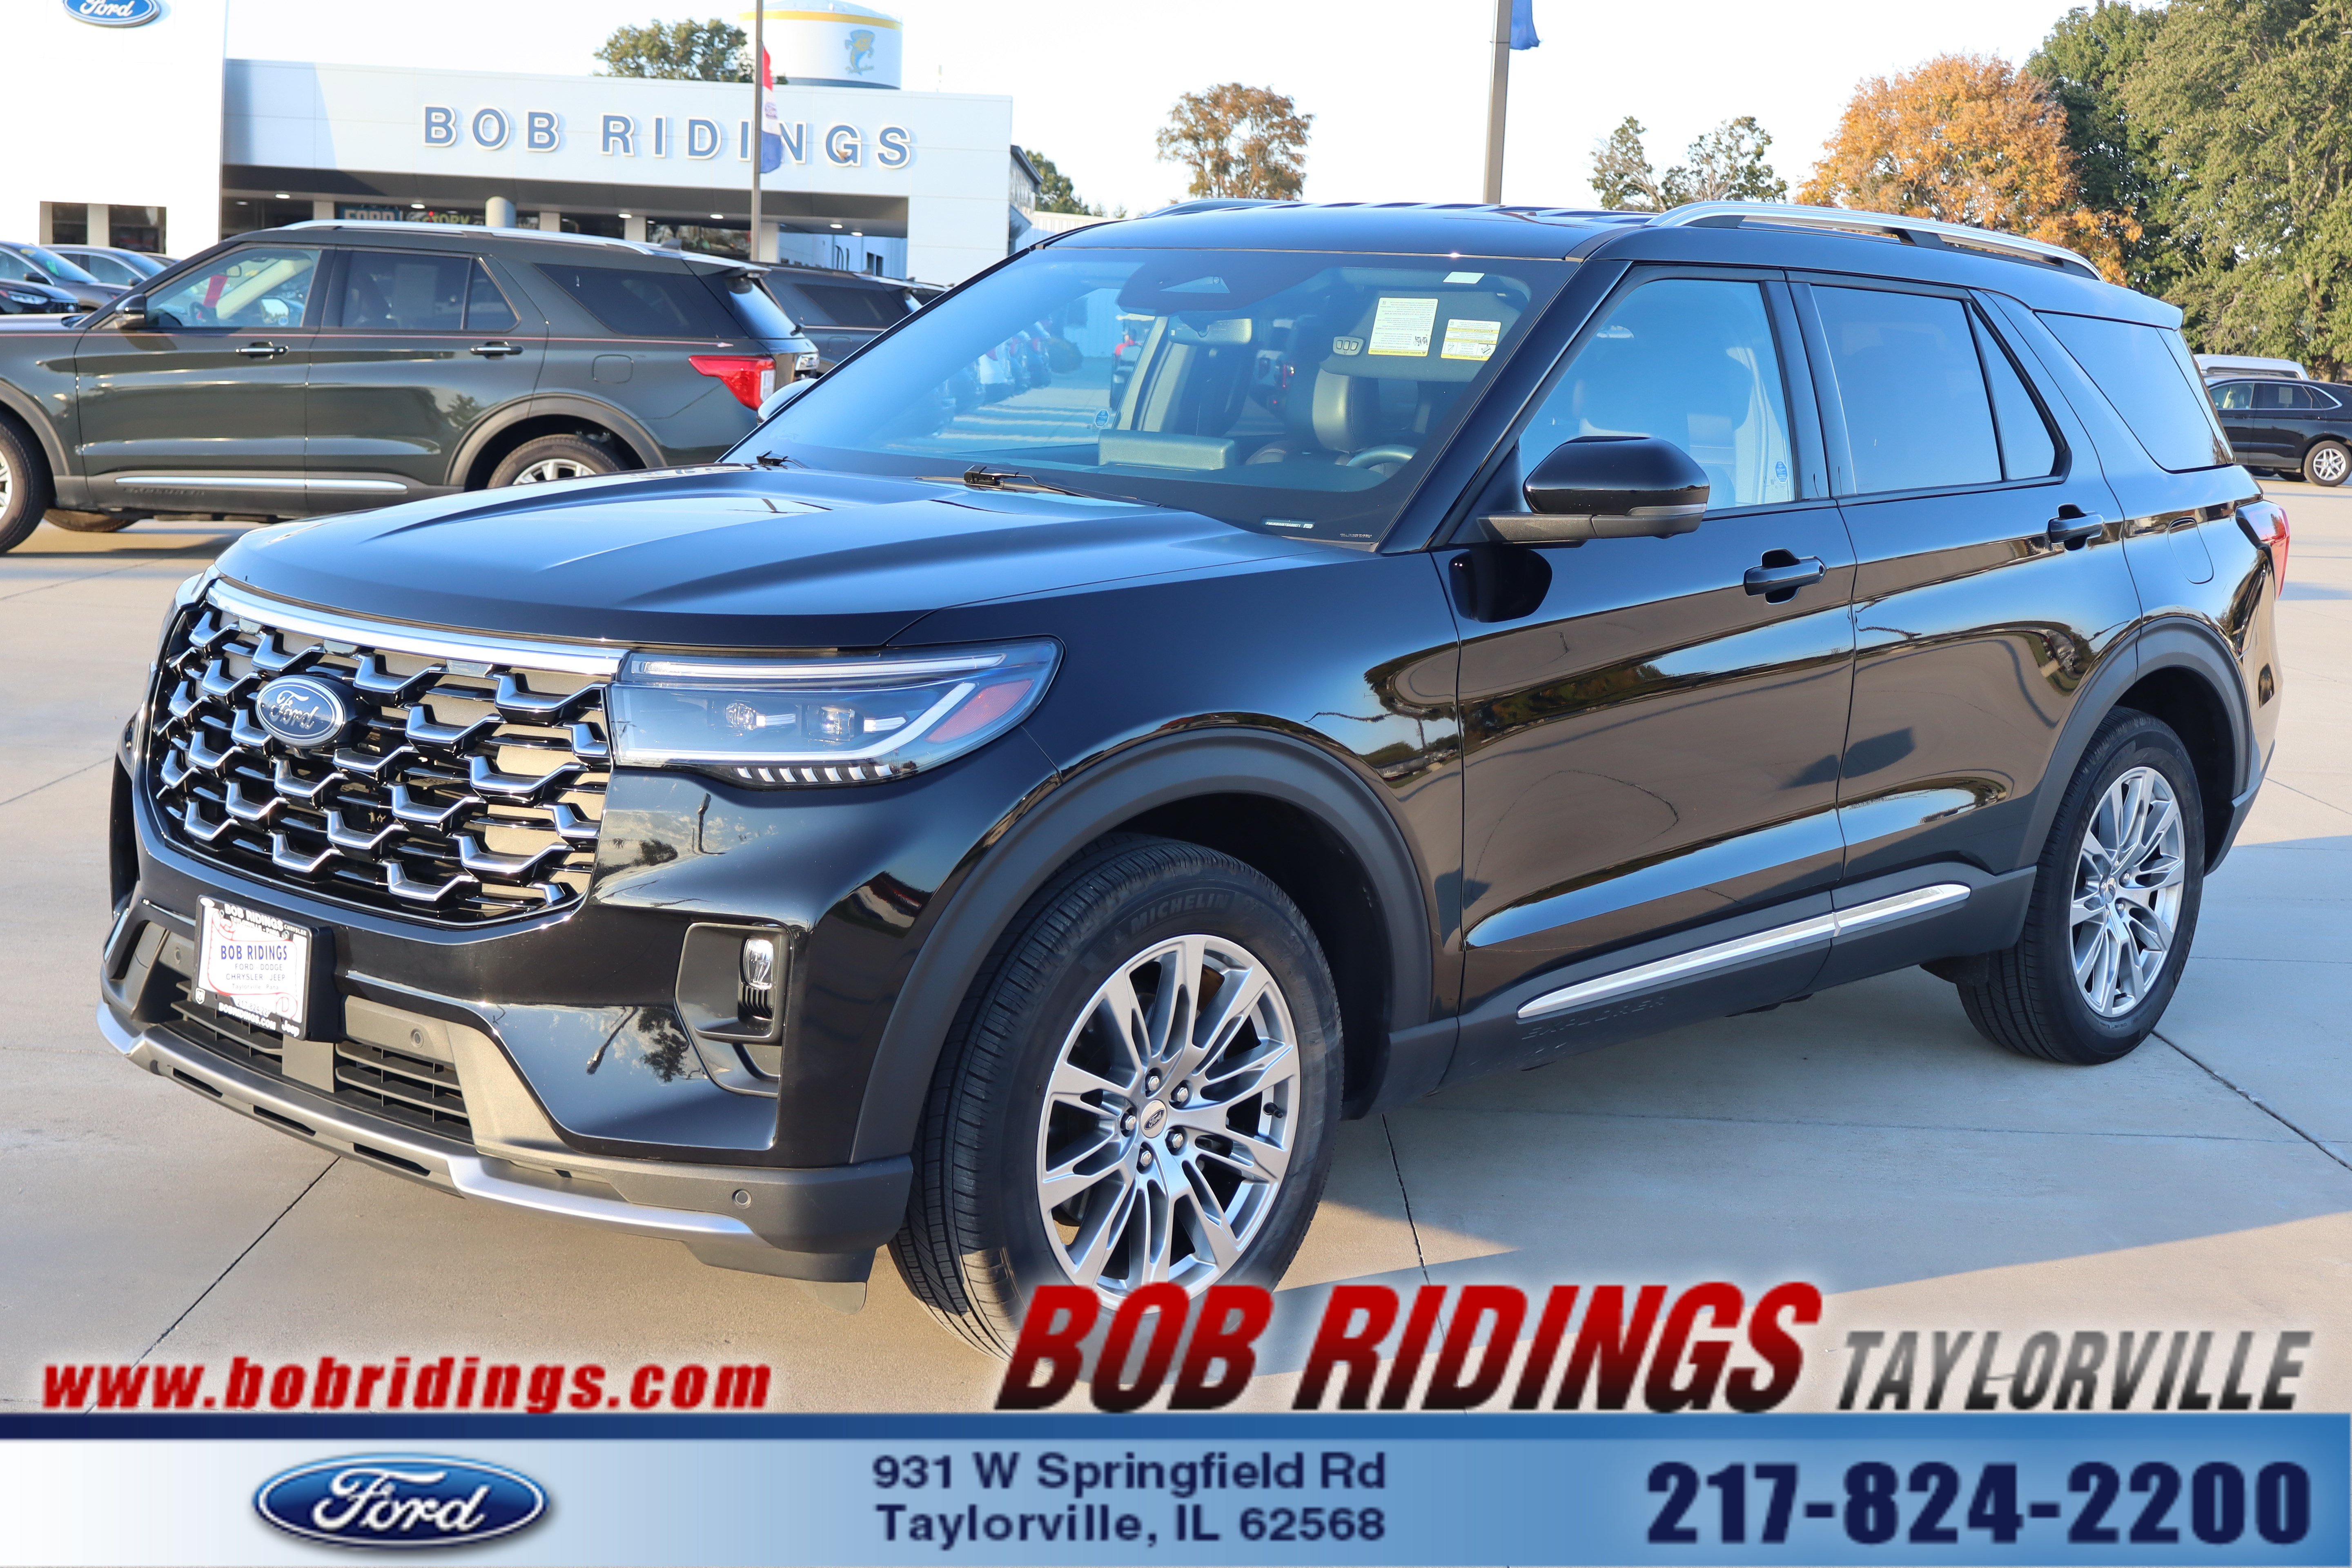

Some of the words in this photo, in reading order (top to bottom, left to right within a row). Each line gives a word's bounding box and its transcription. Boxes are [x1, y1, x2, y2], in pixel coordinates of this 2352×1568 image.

[80, 0, 135, 16] Ford
[424, 105, 560, 152] BOB
[600, 113, 911, 168] RIDINGS
[270, 690, 319, 730] Ford
[224, 903, 245, 918] BOB
[245, 909, 284, 931] RIDINGS
[1131, 893, 1229, 935] MICHELIN
[284, 924, 307, 936] CHRYSLER
[221, 945, 242, 960] BOB
[247, 945, 287, 960] RIDINGS
[281, 1020, 300, 1038] Jeep
[1149, 1111, 1161, 1127] Ford
